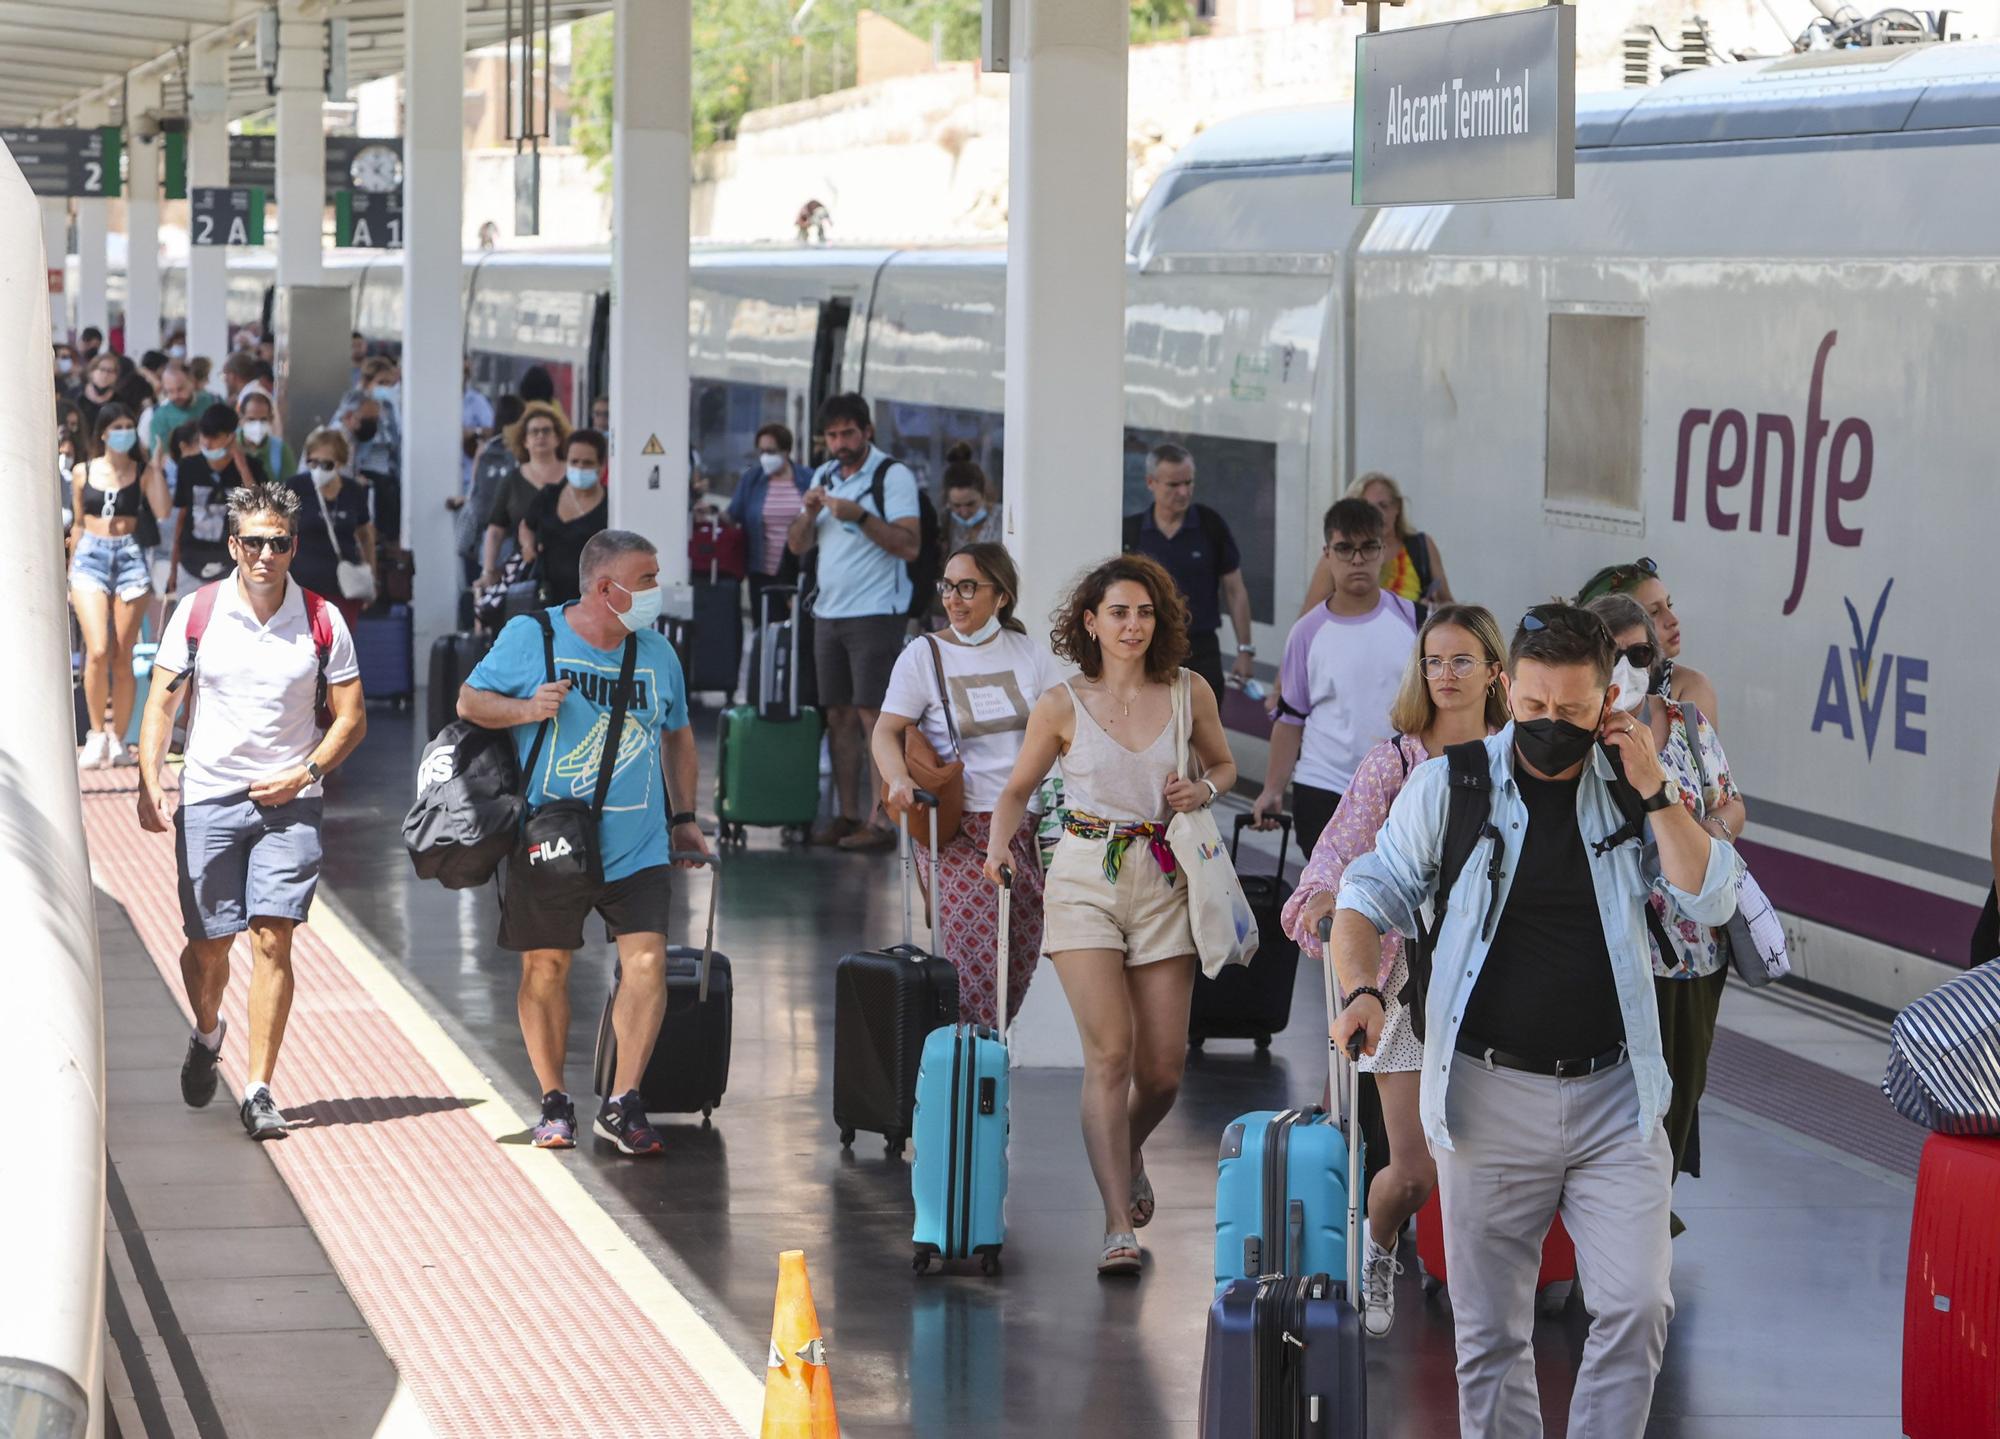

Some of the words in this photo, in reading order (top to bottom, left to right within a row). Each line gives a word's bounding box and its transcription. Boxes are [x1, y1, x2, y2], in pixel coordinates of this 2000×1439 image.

[1386, 81, 1447, 145] Alacant
[1452, 68, 1529, 139] Terminal
[84, 162, 102, 191] 2
[196, 215, 214, 244] 2
[227, 216, 248, 244] A
[352, 218, 372, 246] A
[386, 218, 403, 247] 1
[1672, 329, 1874, 617] renfe
[1811, 577, 1929, 763] AVE
[528, 836, 572, 866] FILA
